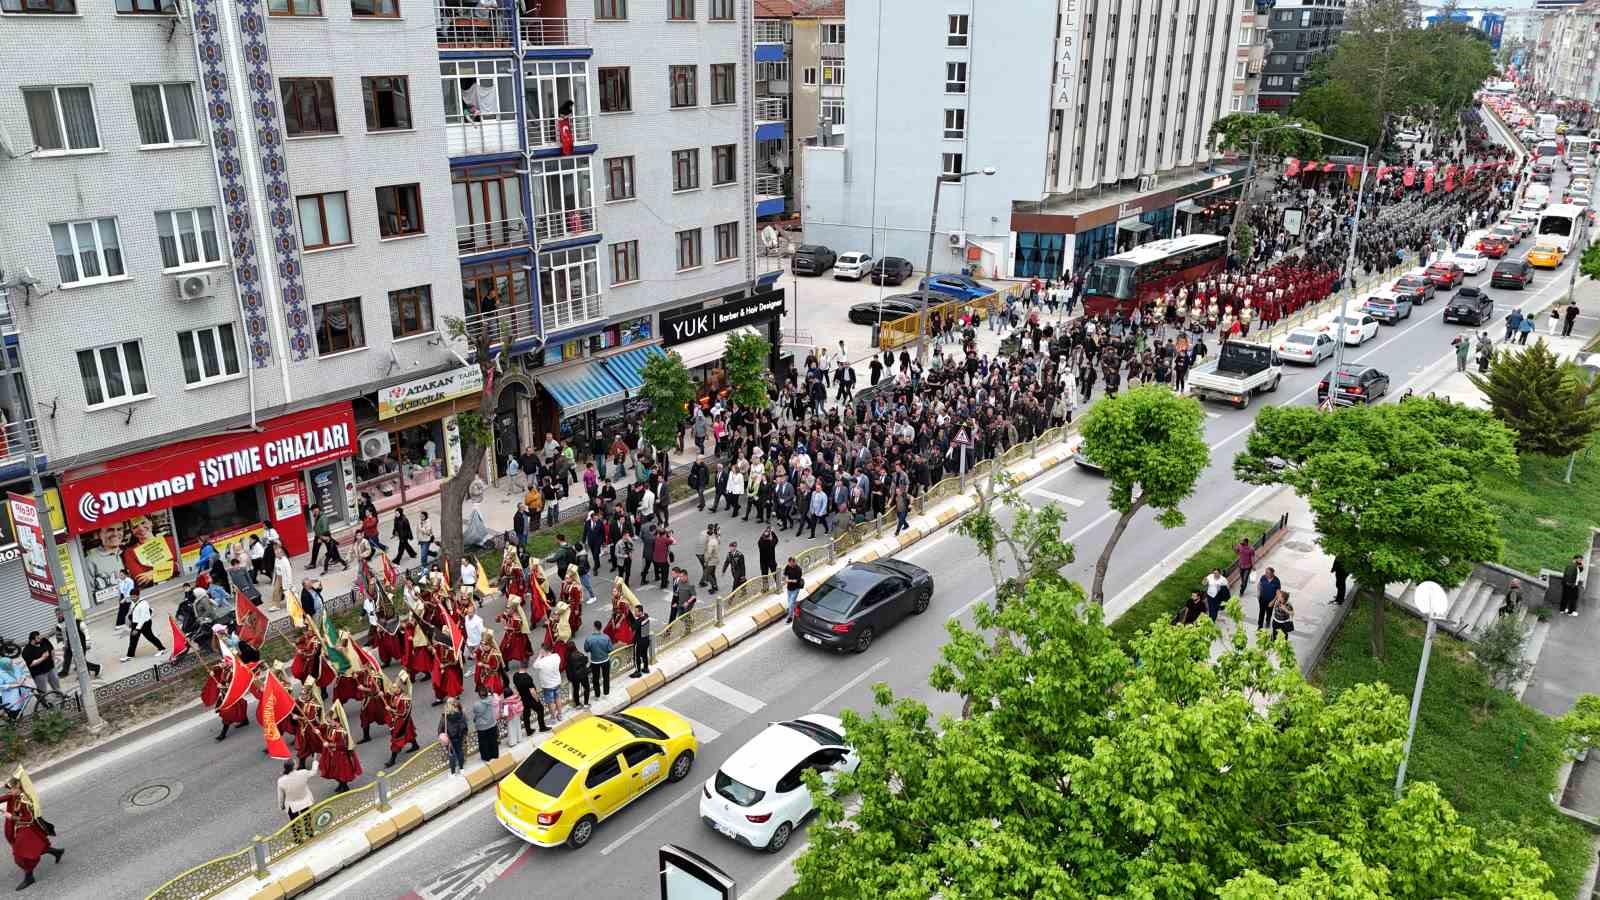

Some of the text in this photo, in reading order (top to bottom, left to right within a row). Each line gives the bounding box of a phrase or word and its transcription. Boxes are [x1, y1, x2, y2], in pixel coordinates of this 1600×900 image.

[1058, 36, 1072, 103] BALTA
[673, 314, 708, 340] YUK
[719, 311, 739, 323] Barber
[746, 305, 758, 316] Hair
[759, 299, 783, 312] Designer
[405, 376, 454, 396] ATAKAN
[99, 472, 196, 515] Duymer
